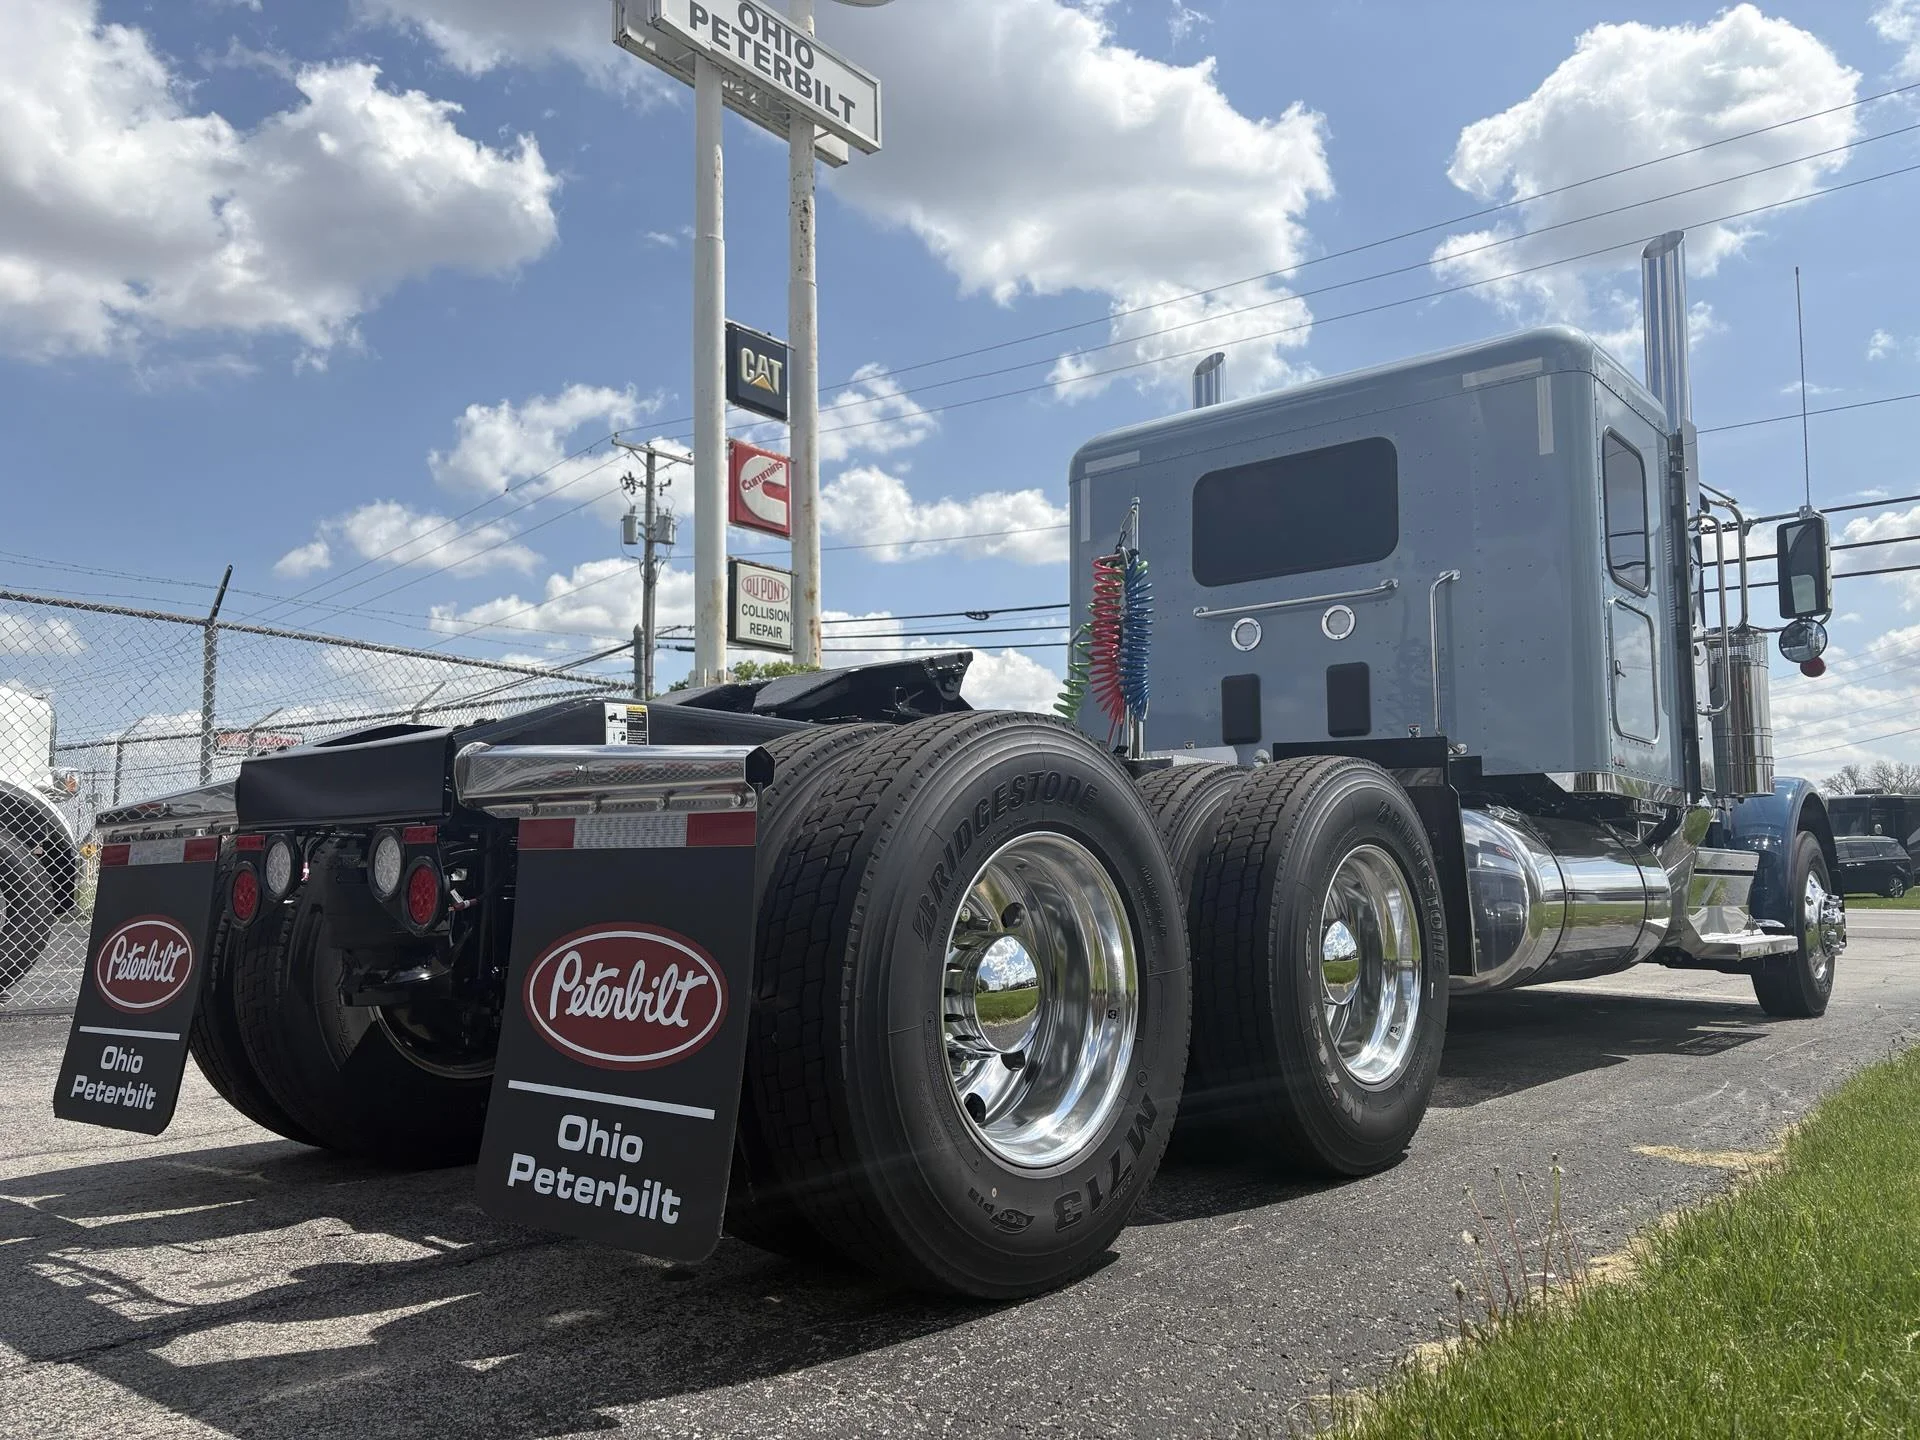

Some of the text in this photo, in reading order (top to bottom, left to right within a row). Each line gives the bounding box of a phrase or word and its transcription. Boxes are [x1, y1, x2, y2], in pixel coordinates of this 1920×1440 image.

[738, 2, 814, 70] OHIO
[690, 2, 855, 124] PETERBILT
[741, 347, 783, 395] CAT
[741, 462, 783, 491] Cummins
[741, 603, 790, 623] COLLISION
[750, 622, 782, 639] REPAIR
[913, 770, 1098, 951] BRIDGESTONE
[107, 935, 187, 984] Peterbilt
[549, 950, 708, 1028] Peterbilt
[100, 1046, 143, 1074] Ohio
[70, 1075, 157, 1110] Peterbilt
[557, 1114, 644, 1163] Ohio
[1053, 1092, 1158, 1233] M713
[507, 1153, 681, 1225] Peterbilt
